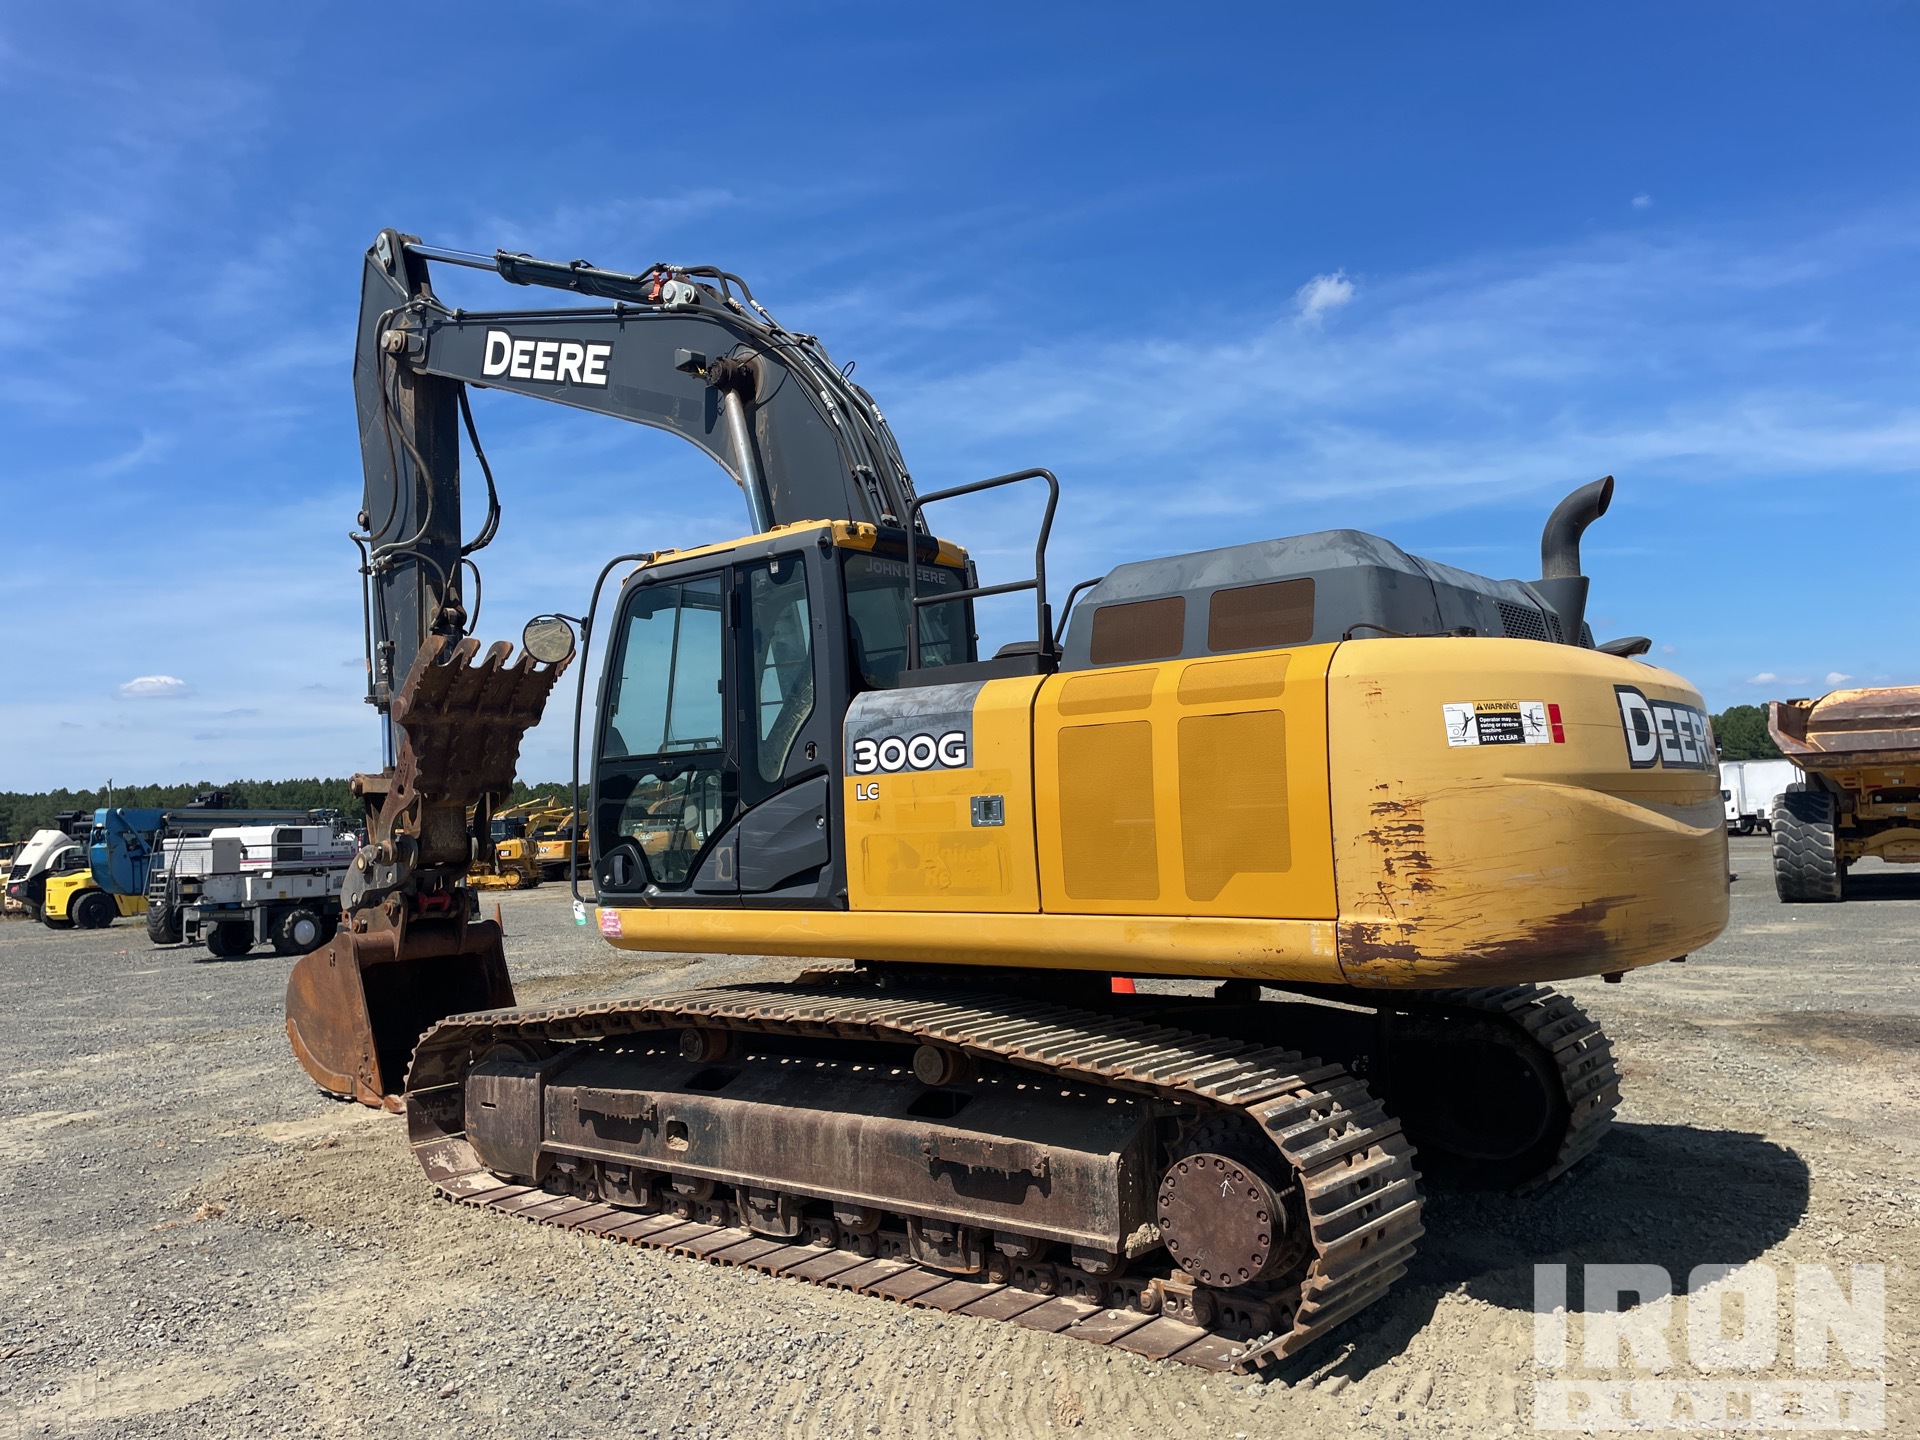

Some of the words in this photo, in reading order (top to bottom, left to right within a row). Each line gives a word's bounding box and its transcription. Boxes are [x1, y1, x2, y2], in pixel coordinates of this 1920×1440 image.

[482, 329, 612, 386] DEERE
[865, 558, 901, 577] JOHN
[1482, 702, 1518, 710] WARNING
[854, 730, 968, 774] 300G
[856, 783, 880, 801] LC
